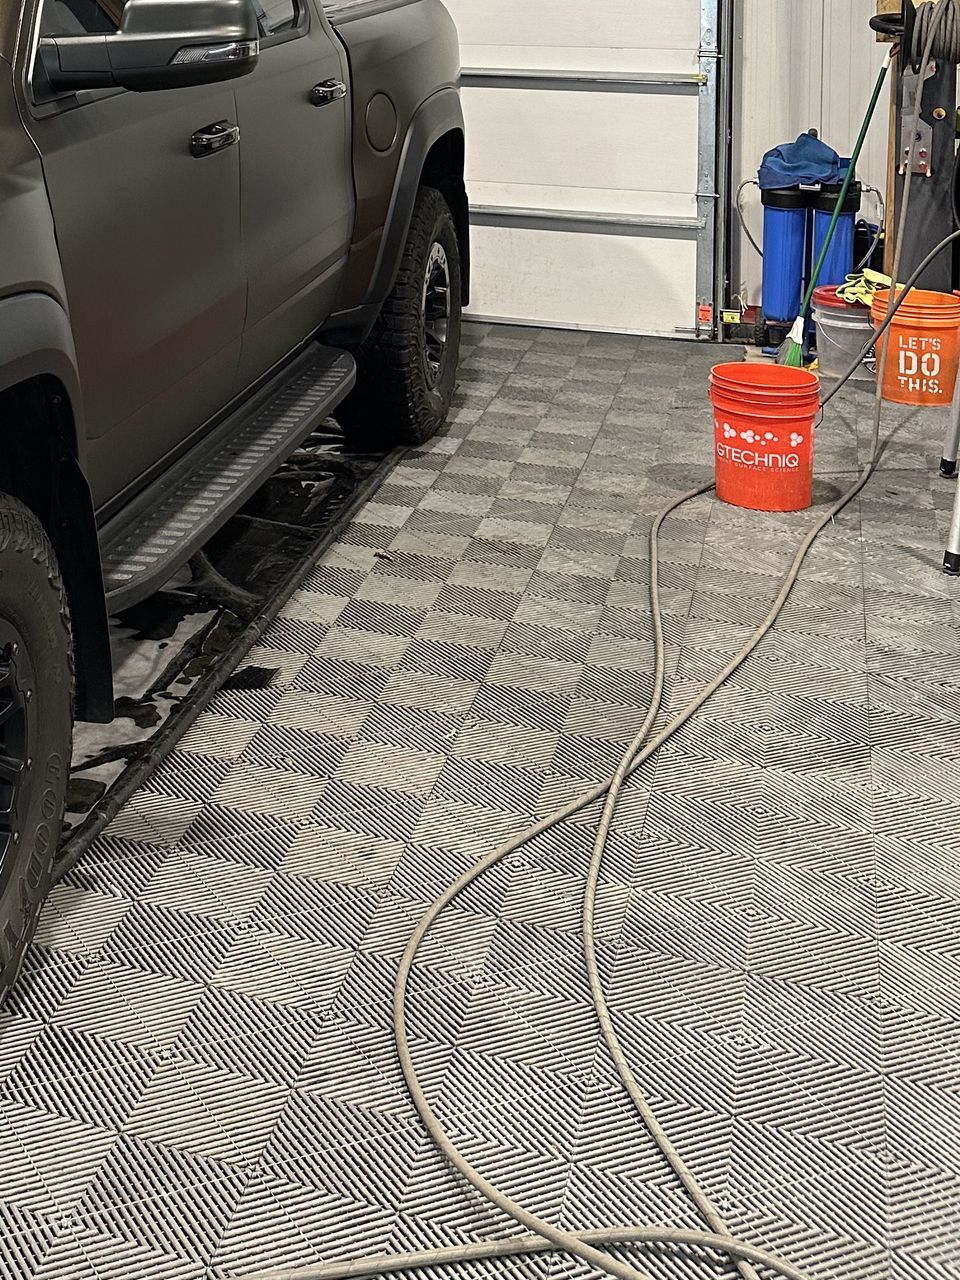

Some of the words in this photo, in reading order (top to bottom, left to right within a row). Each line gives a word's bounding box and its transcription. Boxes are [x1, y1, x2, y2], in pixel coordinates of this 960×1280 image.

[899, 335, 941, 350] LET'S
[898, 350, 940, 377] DO
[897, 375, 943, 394] THIS.
[716, 442, 799, 468] GTECHNIQ
